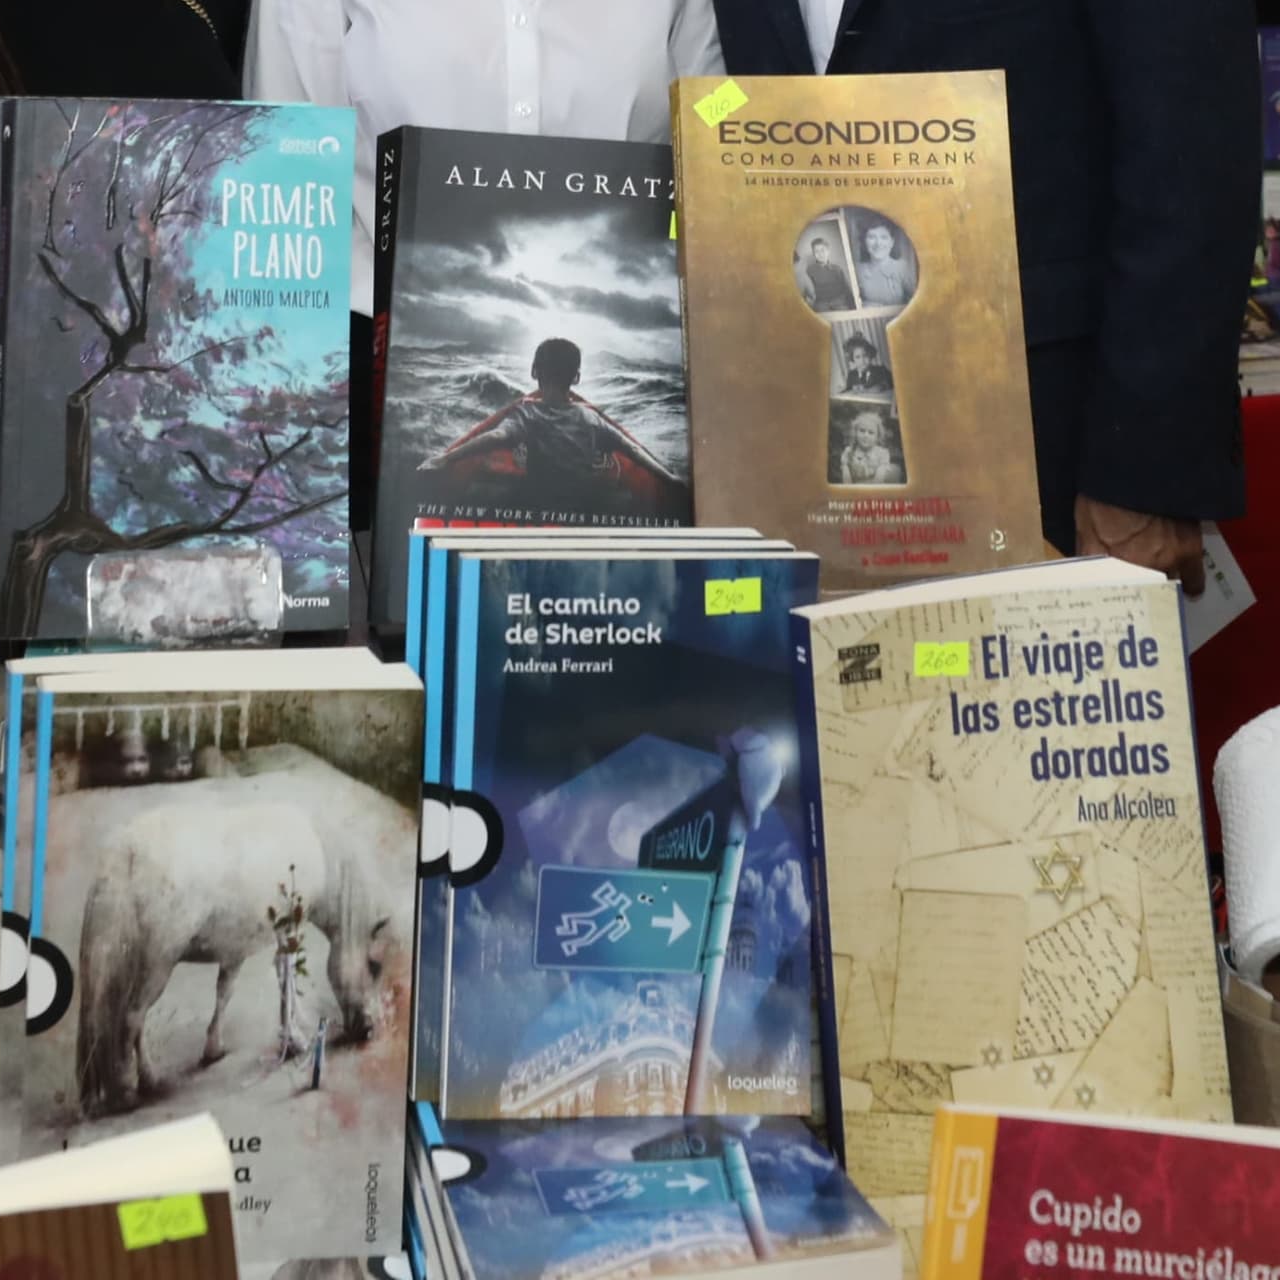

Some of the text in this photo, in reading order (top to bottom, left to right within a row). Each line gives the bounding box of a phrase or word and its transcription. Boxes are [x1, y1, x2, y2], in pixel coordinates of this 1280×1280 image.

[719, 119, 976, 145] ESCONDIDOS
[721, 150, 976, 167] COMO ANNE FRANK
[445, 165, 547, 191] ALAN
[762, 176, 830, 187] HISTORIAS
[834, 177, 849, 187] DE
[854, 176, 955, 187] SUPERVIVENCIA
[222, 179, 337, 230] PRIMER
[380, 148, 396, 252] GRATZ
[232, 231, 323, 280] PLANO
[223, 289, 331, 309] ANTONIO MALPICA
[417, 503, 447, 517] THE
[453, 505, 487, 518] NEW
[494, 508, 534, 521] YORK
[541, 511, 585, 524] TIMES
[592, 514, 680, 528] BESTSELLER
[283, 593, 331, 609] Norma
[507, 593, 641, 616] El camino
[505, 622, 663, 646] de Sherlock
[503, 657, 614, 674] Andrea Ferrari
[981, 625, 1158, 684] El viaje de
[950, 679, 1165, 735] las estrellas
[1030, 732, 1171, 781] doradas
[1078, 791, 1176, 821] Ana Alcolea
[727, 1073, 799, 1096] loqueleo
[227, 1134, 262, 1154] ue
[236, 1195, 272, 1213] dley
[1028, 1189, 1142, 1238] Cupido
[1024, 1238, 1058, 1265] es
[1066, 1242, 1106, 1272] un
